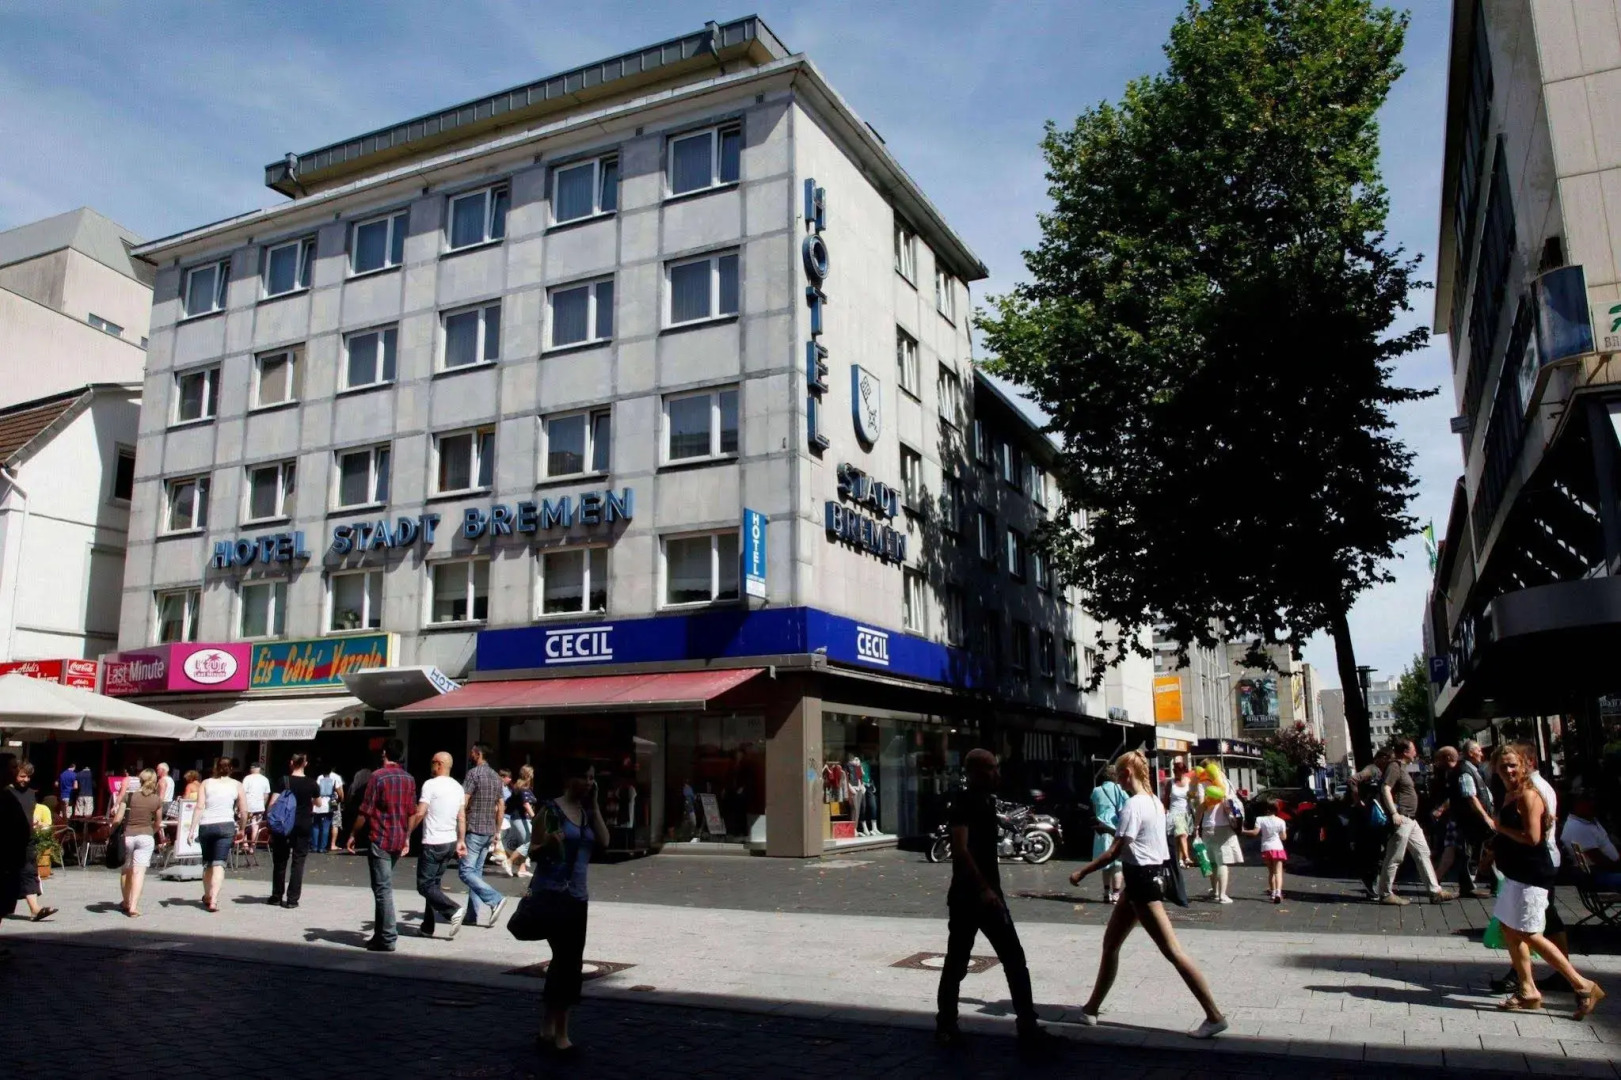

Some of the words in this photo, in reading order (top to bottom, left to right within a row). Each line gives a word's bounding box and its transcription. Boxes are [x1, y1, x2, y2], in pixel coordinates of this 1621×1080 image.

[804, 177, 830, 450] HOTEL
[837, 463, 901, 517] STADT
[212, 531, 312, 569] HOTEL
[333, 513, 441, 555] STADT
[463, 487, 634, 539] BREMEN
[751, 512, 761, 576] HOTEL
[824, 501, 908, 561] BREMEN
[253, 647, 276, 684] Eis
[545, 632, 613, 658] CECIL
[857, 632, 889, 660] CECIL
[1433, 658, 1444, 672] P
[106, 663, 128, 685] Last
[129, 660, 165, 681] Minute
